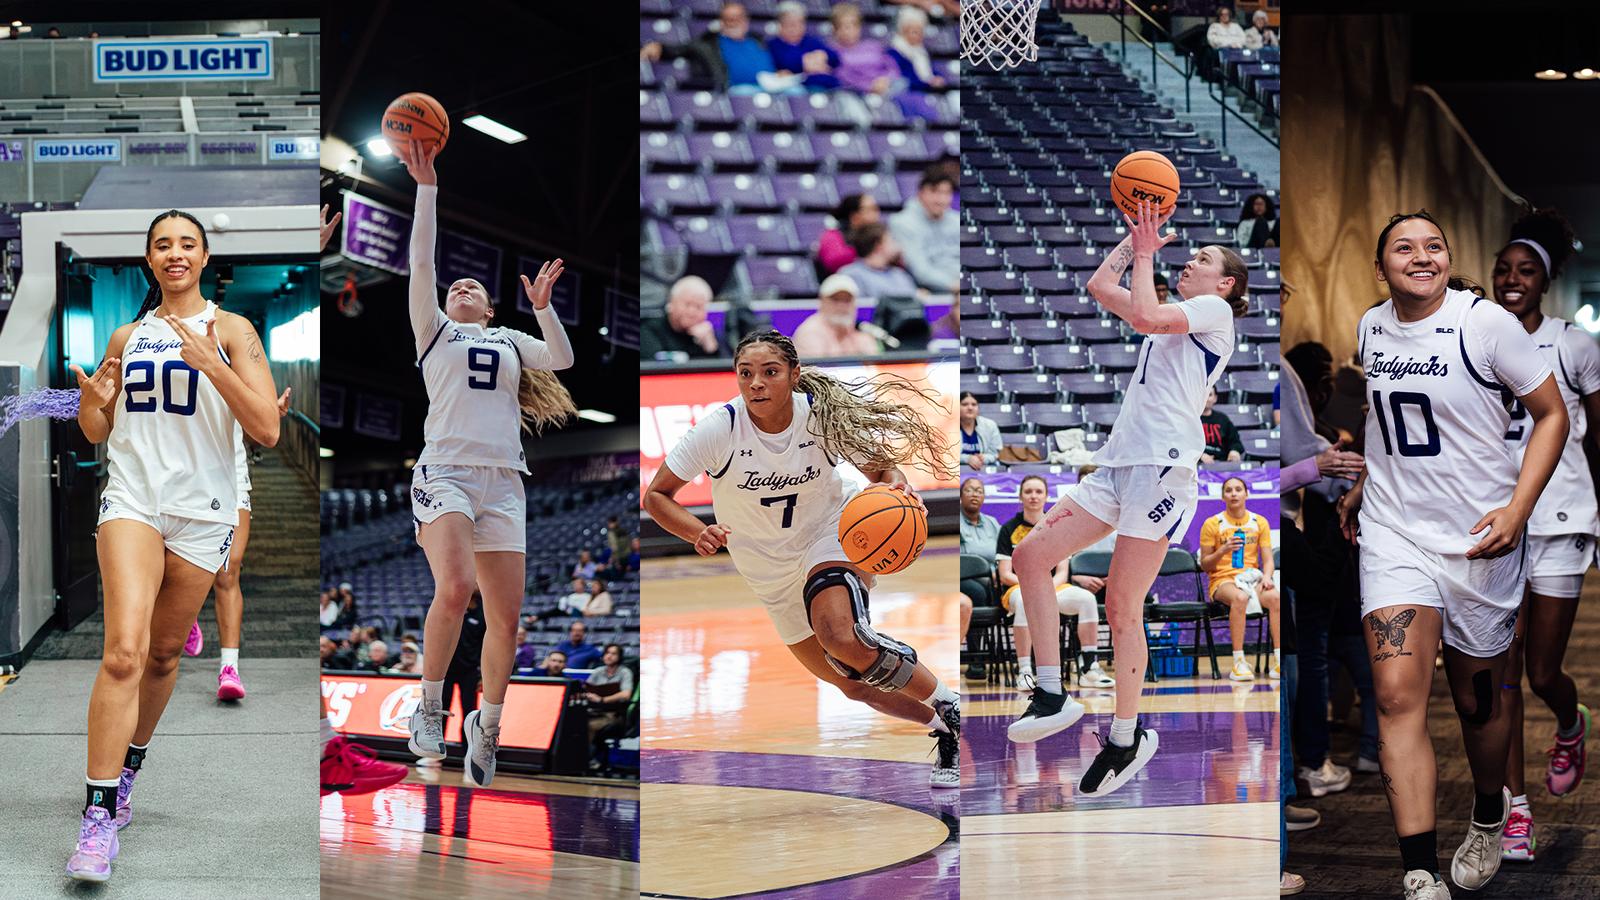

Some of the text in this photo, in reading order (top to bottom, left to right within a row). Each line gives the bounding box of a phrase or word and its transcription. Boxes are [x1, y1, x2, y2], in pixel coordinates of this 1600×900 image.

[105, 48, 262, 72] BUD LIGHT
[386, 119, 412, 134] NCAA
[39, 145, 114, 157] BUD LIGHT
[1131, 187, 1165, 205] NCAA
[129, 337, 184, 355] Ladyja
[468, 347, 500, 391] 9
[1367, 352, 1449, 380] Ladyjacks
[125, 360, 200, 416] 20
[1372, 390, 1442, 457] 10
[737, 466, 821, 491] Ladyjacks
[760, 493, 799, 529] 7
